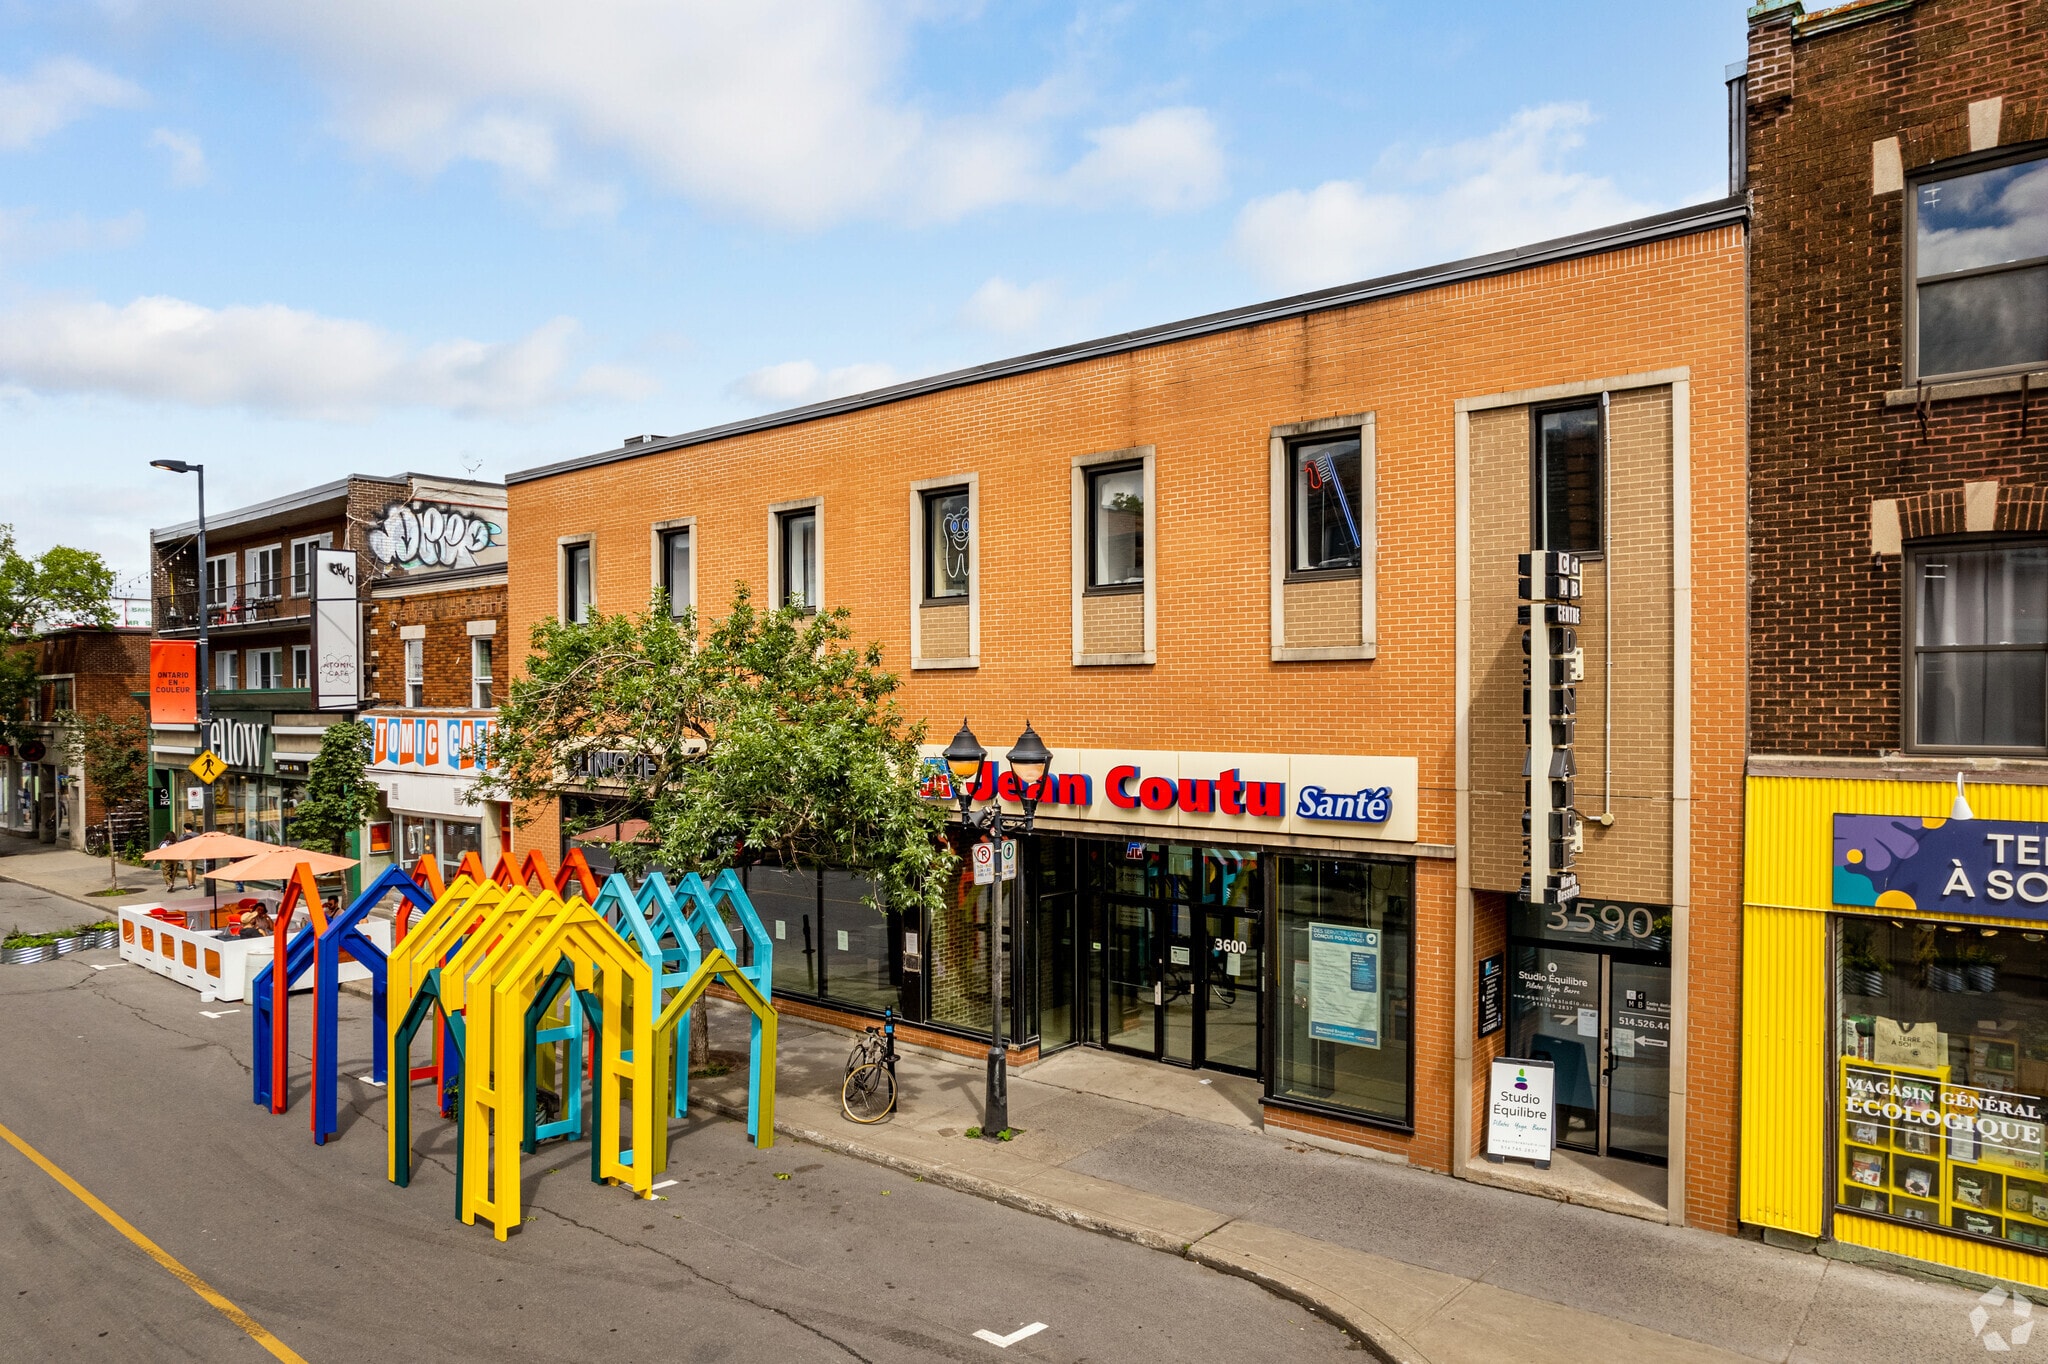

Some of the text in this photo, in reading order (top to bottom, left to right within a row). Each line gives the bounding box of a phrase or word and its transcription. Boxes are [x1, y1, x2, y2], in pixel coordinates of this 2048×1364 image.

[1557, 604, 1580, 624] CENTRE
[208, 717, 264, 767] ellow
[368, 722, 438, 756] TOMIC
[566, 750, 658, 781] LINIQUE
[965, 760, 1392, 822] Jean Coutu Santé
[1987, 833, 2048, 867] TE
[1942, 858, 1976, 898] À
[1546, 902, 1653, 938] 3590
[1215, 938, 1247, 954] 3600
[1518, 971, 1588, 987] Studio Équilibre
[1525, 981, 1580, 995] Pilates Yoga Barre
[1618, 1016, 1670, 1031] 514.526.44
[1899, 1035, 1921, 1043] TERRE
[1501, 1091, 1541, 1105] Studio
[1845, 1077, 2042, 1120] MAGASIN GÉNÉRAL
[1493, 1102, 1547, 1120] Équilibre
[1845, 1095, 2041, 1144] ÉCOLOGIQUE
[1514, 1121, 1528, 1132] Yoga
[1531, 1123, 1548, 1132] Barre
